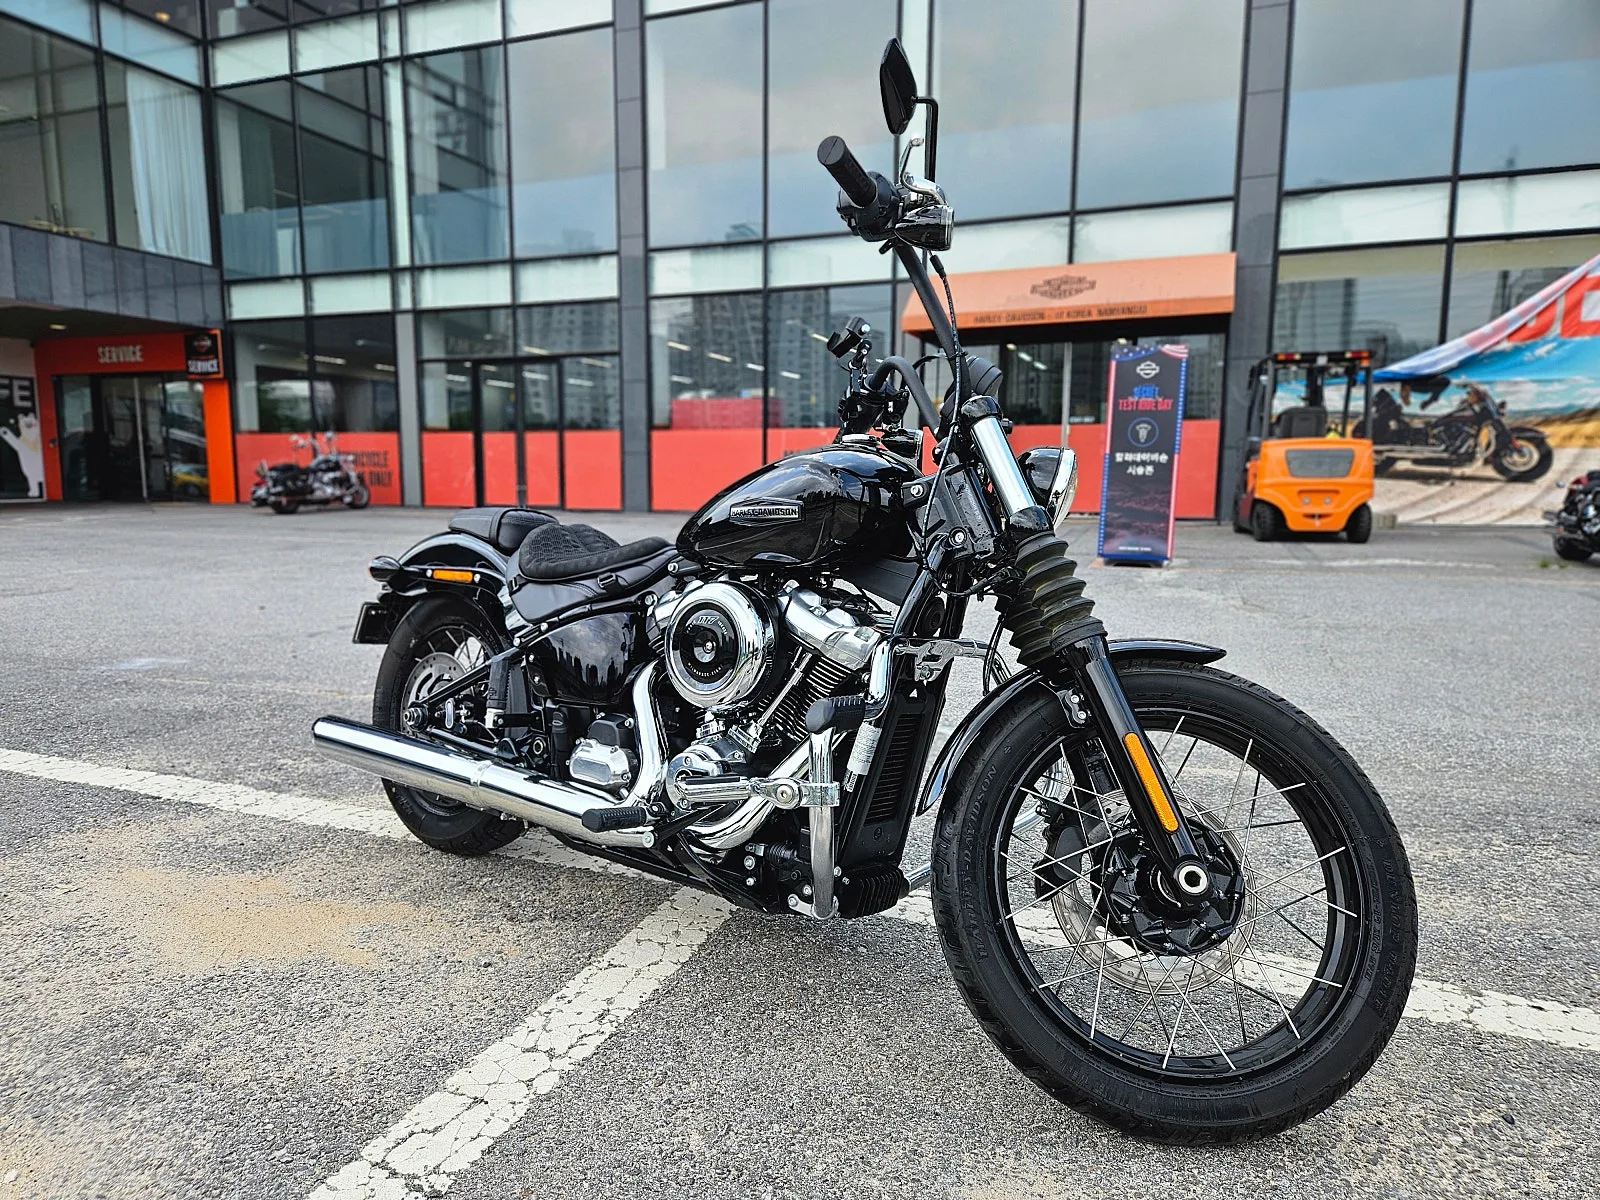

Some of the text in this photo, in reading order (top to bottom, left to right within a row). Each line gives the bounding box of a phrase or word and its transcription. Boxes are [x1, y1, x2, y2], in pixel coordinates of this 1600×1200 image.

[1066, 309, 1092, 319] KOREA
[98, 345, 144, 363] SERVICE
[187, 359, 219, 373] SERVICE
[1119, 399, 1137, 411] TEST
[1157, 399, 1173, 411] DAY
[731, 507, 798, 517] HARLEY-DAVIDSON
[698, 615, 719, 625] 117
